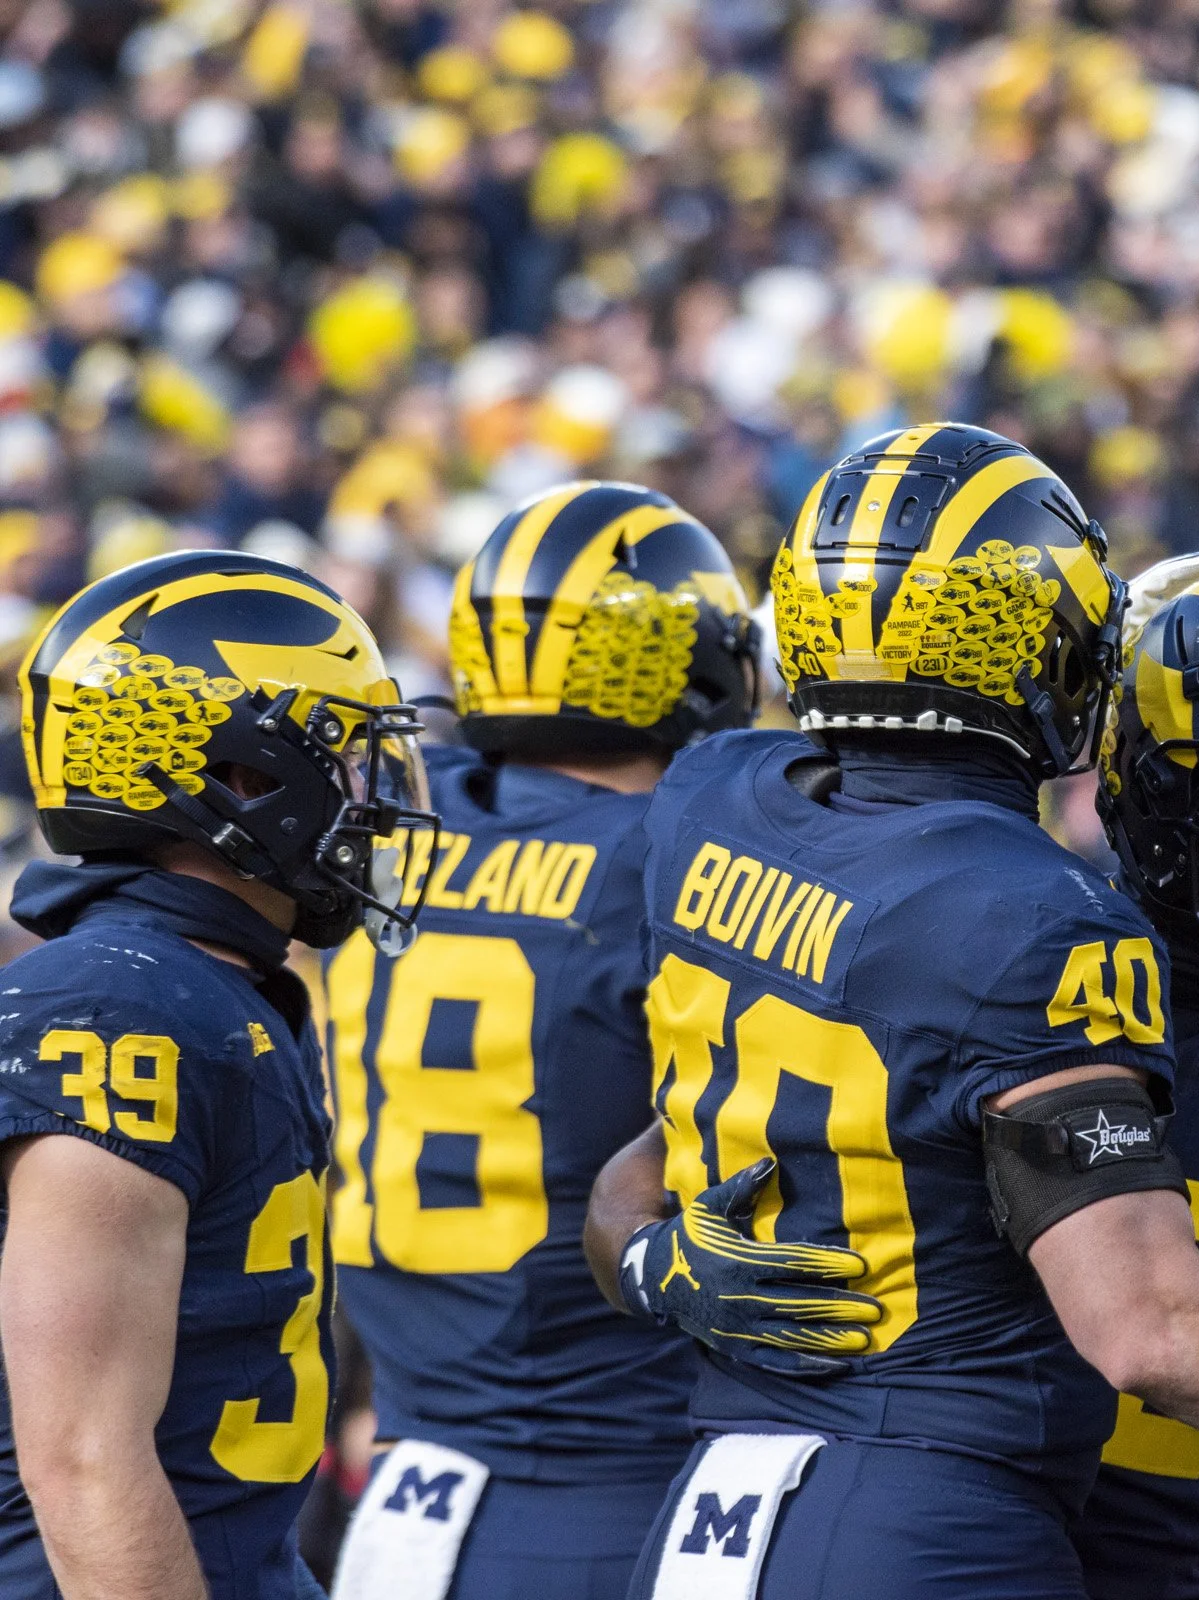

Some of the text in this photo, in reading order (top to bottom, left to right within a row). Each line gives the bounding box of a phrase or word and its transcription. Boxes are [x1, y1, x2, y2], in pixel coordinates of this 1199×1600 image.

[844, 602, 859, 610] 1000
[887, 620, 921, 630] RAMPAGE
[915, 602, 928, 610] 997
[947, 616, 959, 624] 977
[797, 652, 821, 676] 40
[880, 650, 913, 659] VICTORY
[921, 641, 953, 649] EQUALITY
[673, 841, 854, 985] BOIVIN
[1046, 937, 1165, 1046] 40
[39, 1029, 182, 1143] 39
[327, 925, 550, 1274] 18
[643, 952, 919, 1353] 40
[1099, 1126, 1151, 1147] Douglas
[209, 1166, 337, 1484] 3
[384, 1465, 467, 1523] M
[679, 1492, 763, 1558] M
